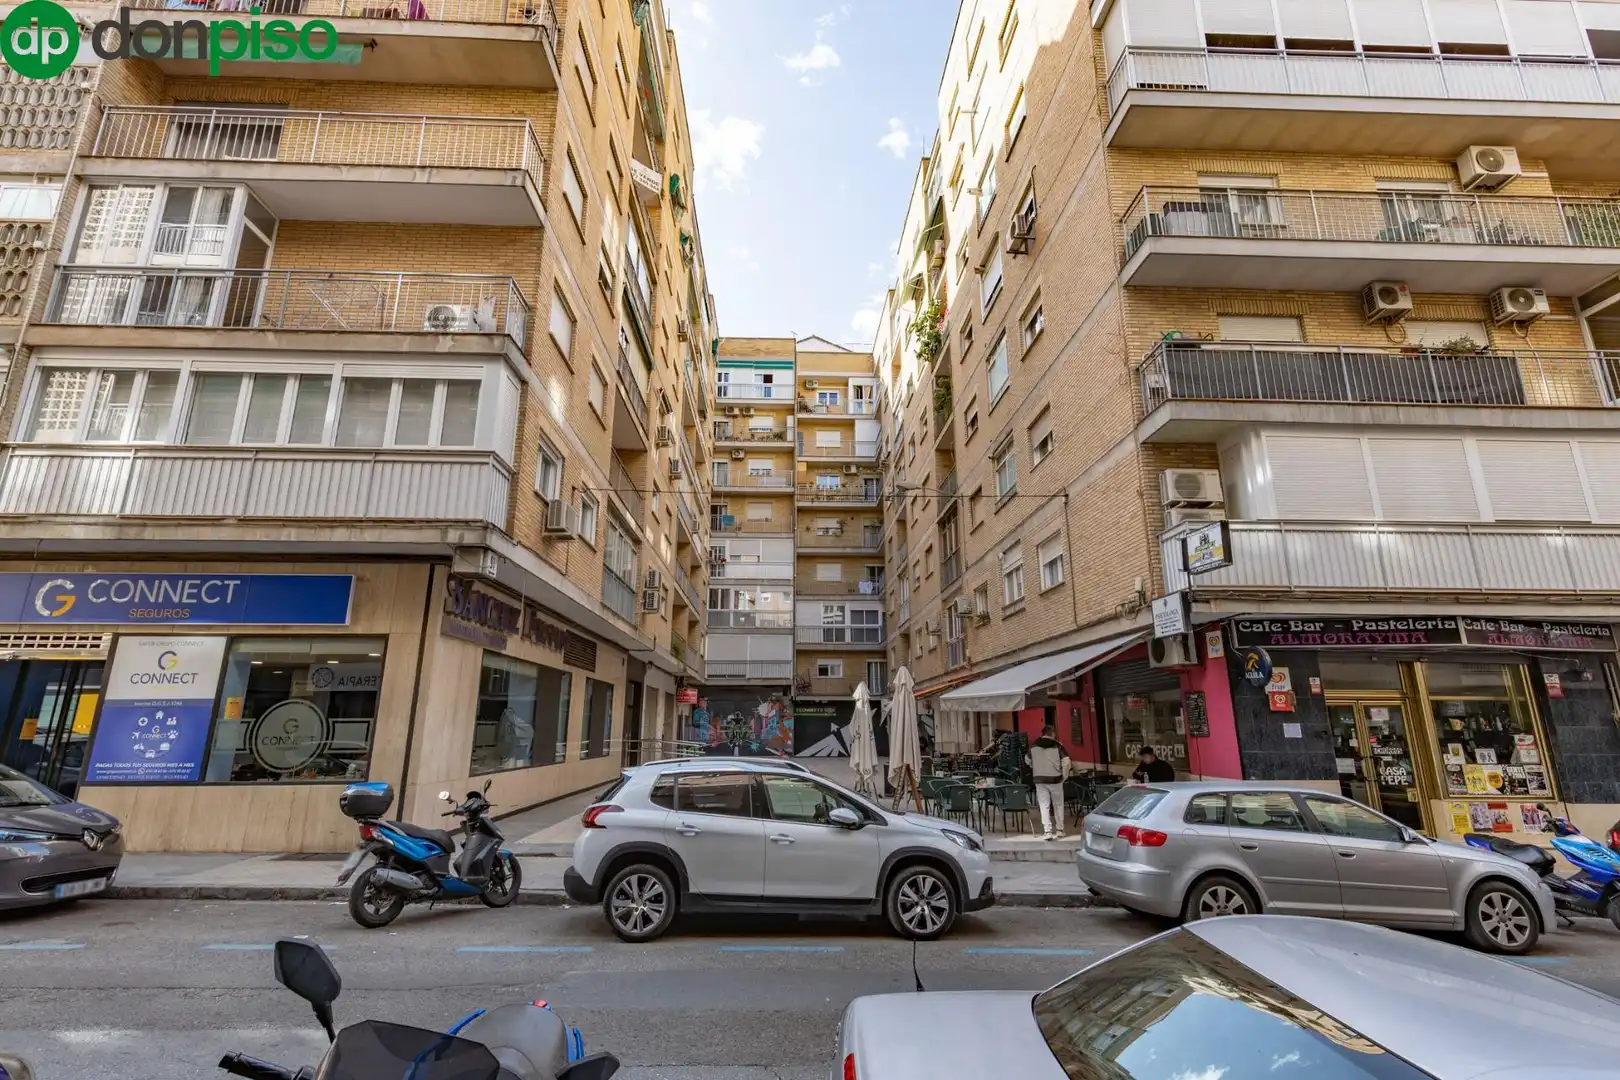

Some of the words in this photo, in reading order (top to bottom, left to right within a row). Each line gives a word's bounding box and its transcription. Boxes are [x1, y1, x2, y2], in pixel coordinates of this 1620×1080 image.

[87, 579, 241, 604] CONNECT
[128, 608, 191, 619] SEGUROS
[130, 672, 199, 685] CONNECT
[1380, 766, 1407, 776] CASA
